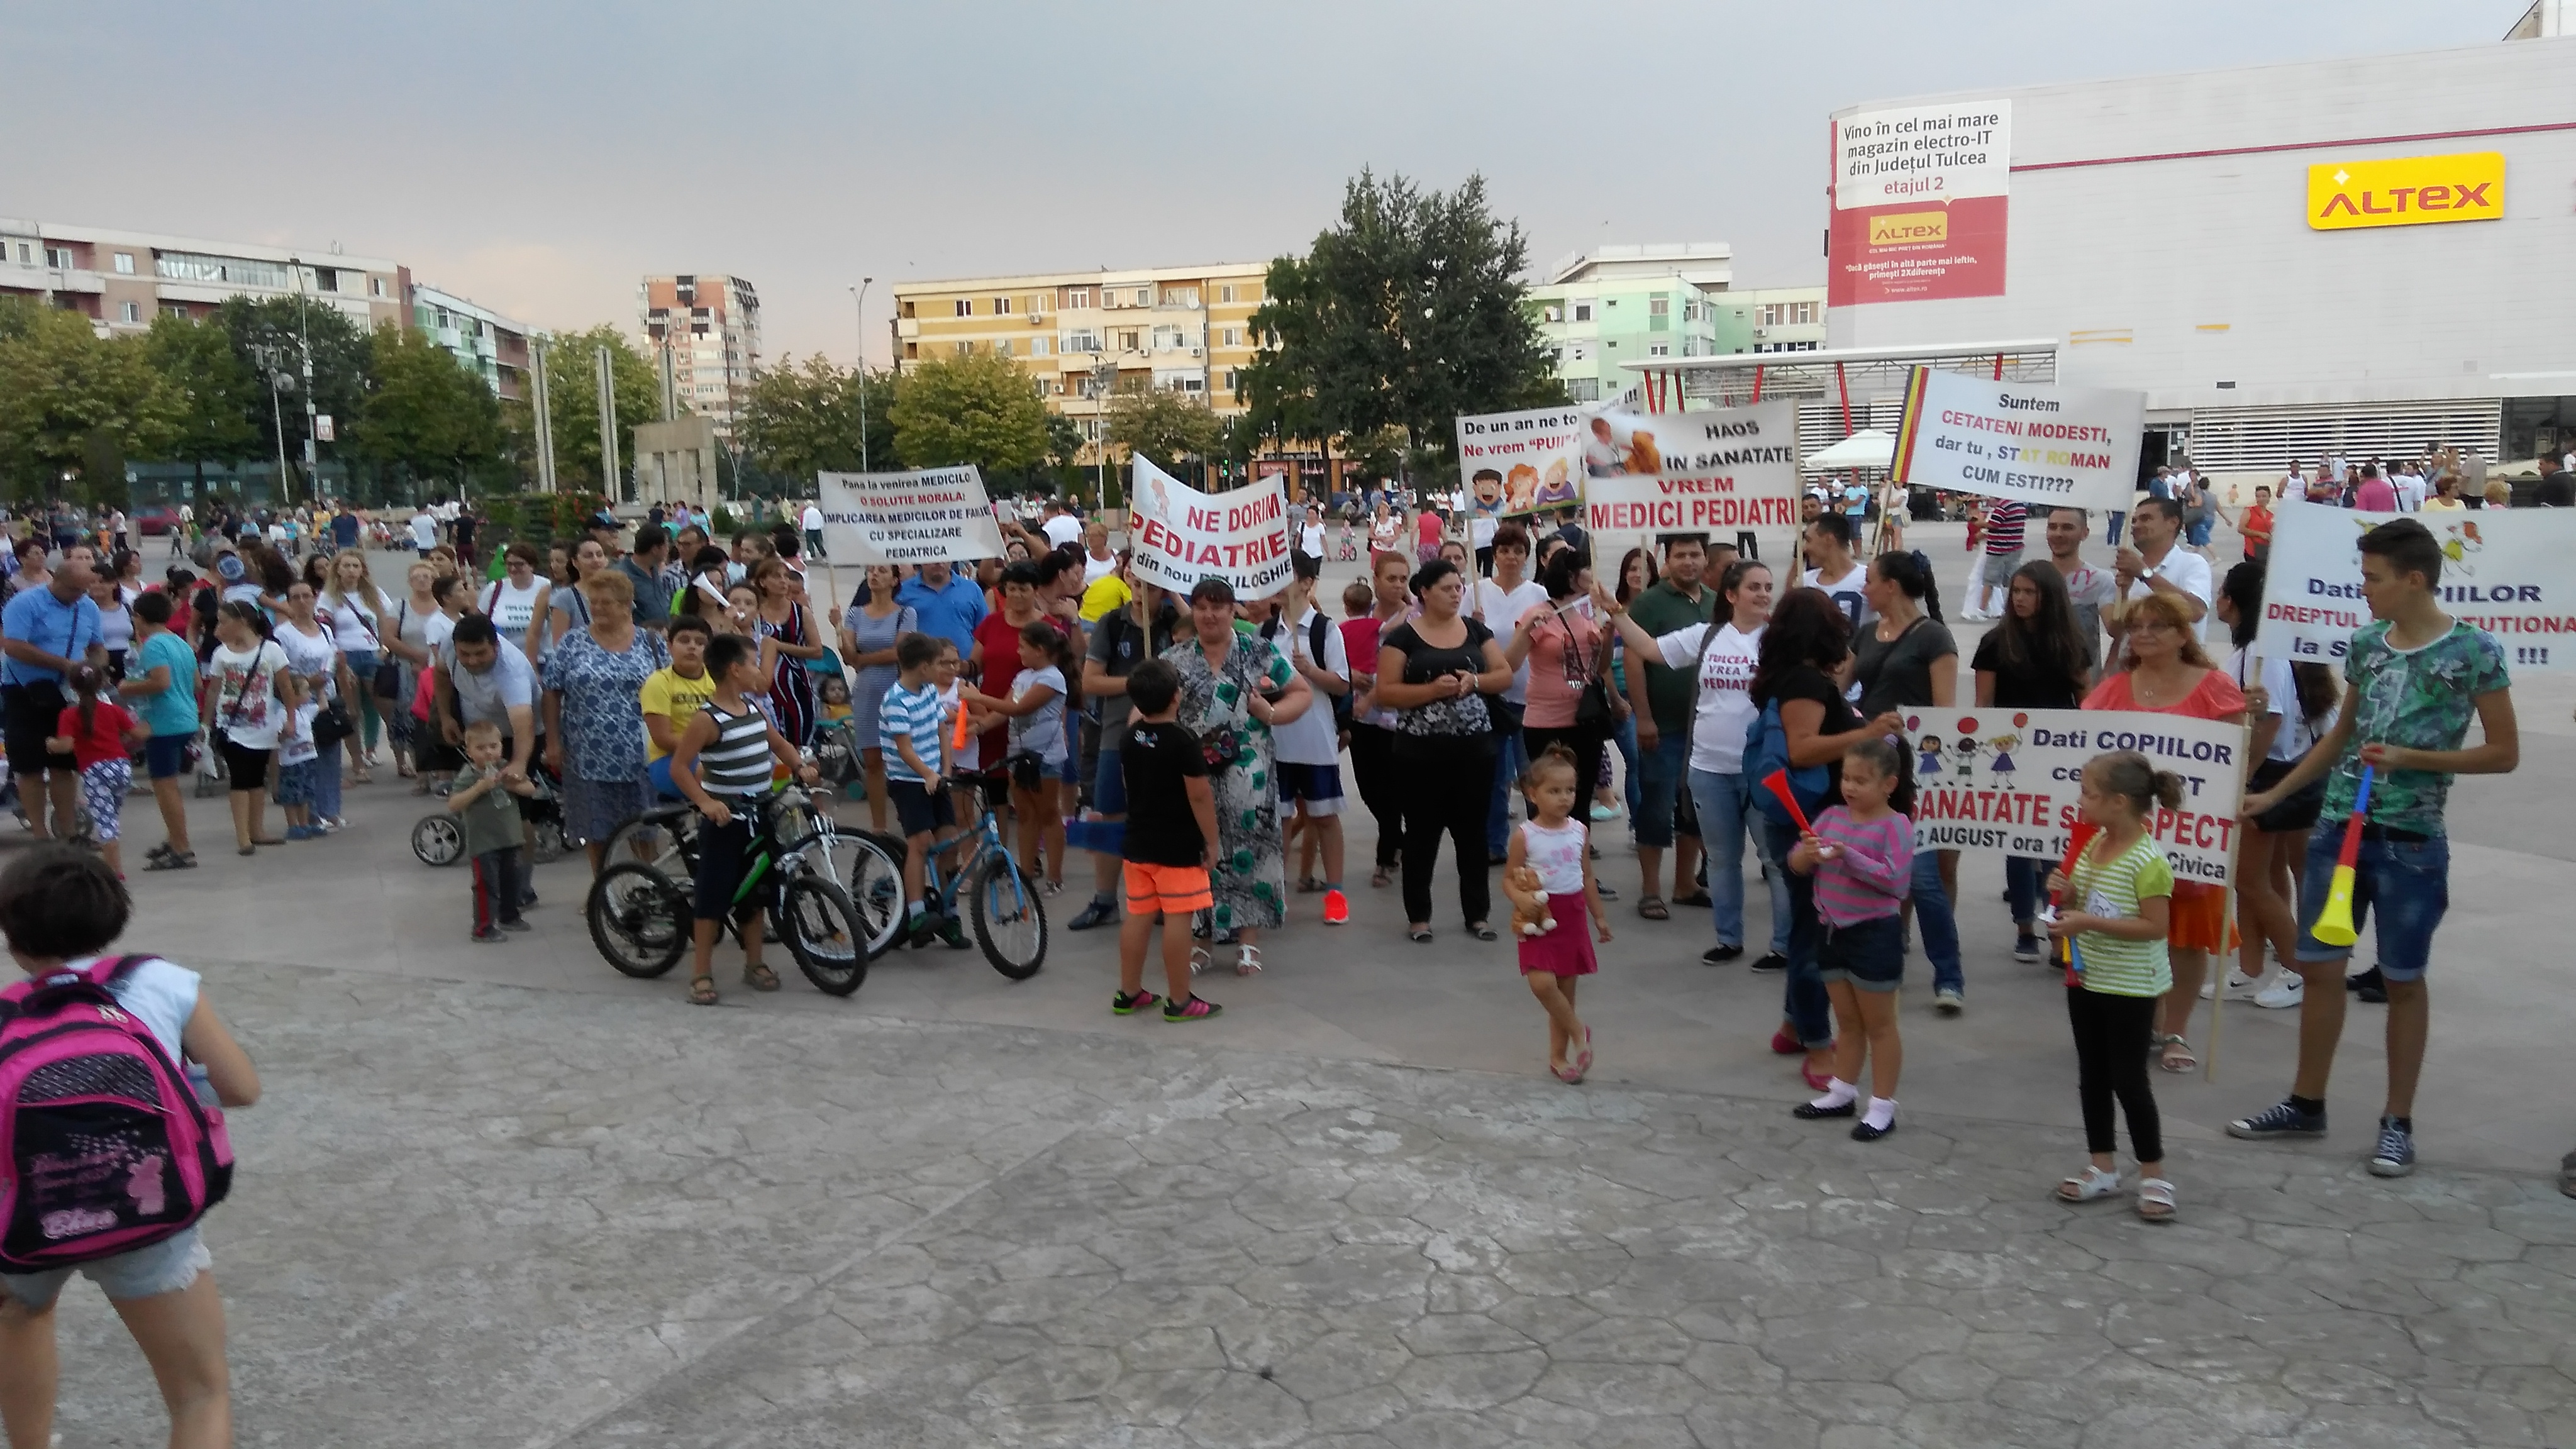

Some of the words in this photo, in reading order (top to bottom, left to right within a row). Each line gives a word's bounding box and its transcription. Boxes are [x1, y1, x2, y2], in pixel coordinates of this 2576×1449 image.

[1845, 126, 1872, 141] Vino
[1877, 121, 1890, 136] în
[1896, 118, 1918, 134] cel
[1923, 114, 1953, 131] mai
[1958, 113, 1999, 127] mare
[1848, 138, 1908, 160] magazin
[1914, 131, 1992, 151] electro-IT
[1850, 160, 1870, 176] din
[1935, 152, 1987, 167] Tulcea
[1884, 177, 1930, 196] etajul
[1935, 177, 1944, 191] 2
[1917, 258, 1937, 268] parte
[1938, 257, 1953, 265] mai
[1999, 394, 2060, 413] Suntem
[1465, 423, 1485, 435] De
[1491, 421, 1509, 433] un
[1514, 419, 1534, 430] an
[1539, 416, 1558, 428] ne
[1705, 421, 1760, 440] HAOS
[1942, 410, 2023, 435] CETATENI
[2028, 423, 2112, 446] MODESTI,
[1464, 444, 1484, 457] Ne
[1489, 441, 1525, 455] vrem
[1667, 455, 1689, 472] IN
[1696, 447, 1794, 470] SANATATE
[1936, 435, 1960, 452] dar
[1967, 441, 1983, 455] tu
[1997, 446, 2041, 464] STAT
[2046, 450, 2111, 469] ROMAN
[880, 478, 918, 490] venirea
[1658, 477, 1734, 496] VREM
[1962, 465, 1999, 484] CUM
[2006, 473, 2075, 493] ESTI???
[870, 494, 914, 508] SOLUTIE
[824, 513, 886, 524] IMPLICAREA
[889, 509, 947, 524] MEDICILOR
[950, 509, 963, 519] DE
[1187, 505, 1220, 533] NE
[1228, 492, 1282, 533] DORIM
[1592, 500, 1683, 530] MEDICI
[1693, 497, 1796, 527] PEDIATRI
[870, 530, 884, 541] CU
[888, 527, 962, 541] SPECIALIZARE
[1133, 511, 1288, 568] PEDIATRIE
[886, 546, 948, 558] PEDIATRICA
[1137, 550, 1160, 572] din
[1164, 565, 1193, 584] nou
[2268, 603, 2362, 628] DREPTUL
[2294, 636, 2319, 654] la
[1709, 654, 1749, 664] TULCEA
[1709, 665, 1741, 675] VREA
[2033, 728, 2088, 748] Dati
[2097, 731, 2232, 765] COPIILOR
[1929, 826, 2007, 849] AUGUST
[2014, 836, 2043, 852] ora
[2167, 851, 2226, 879] Civica
